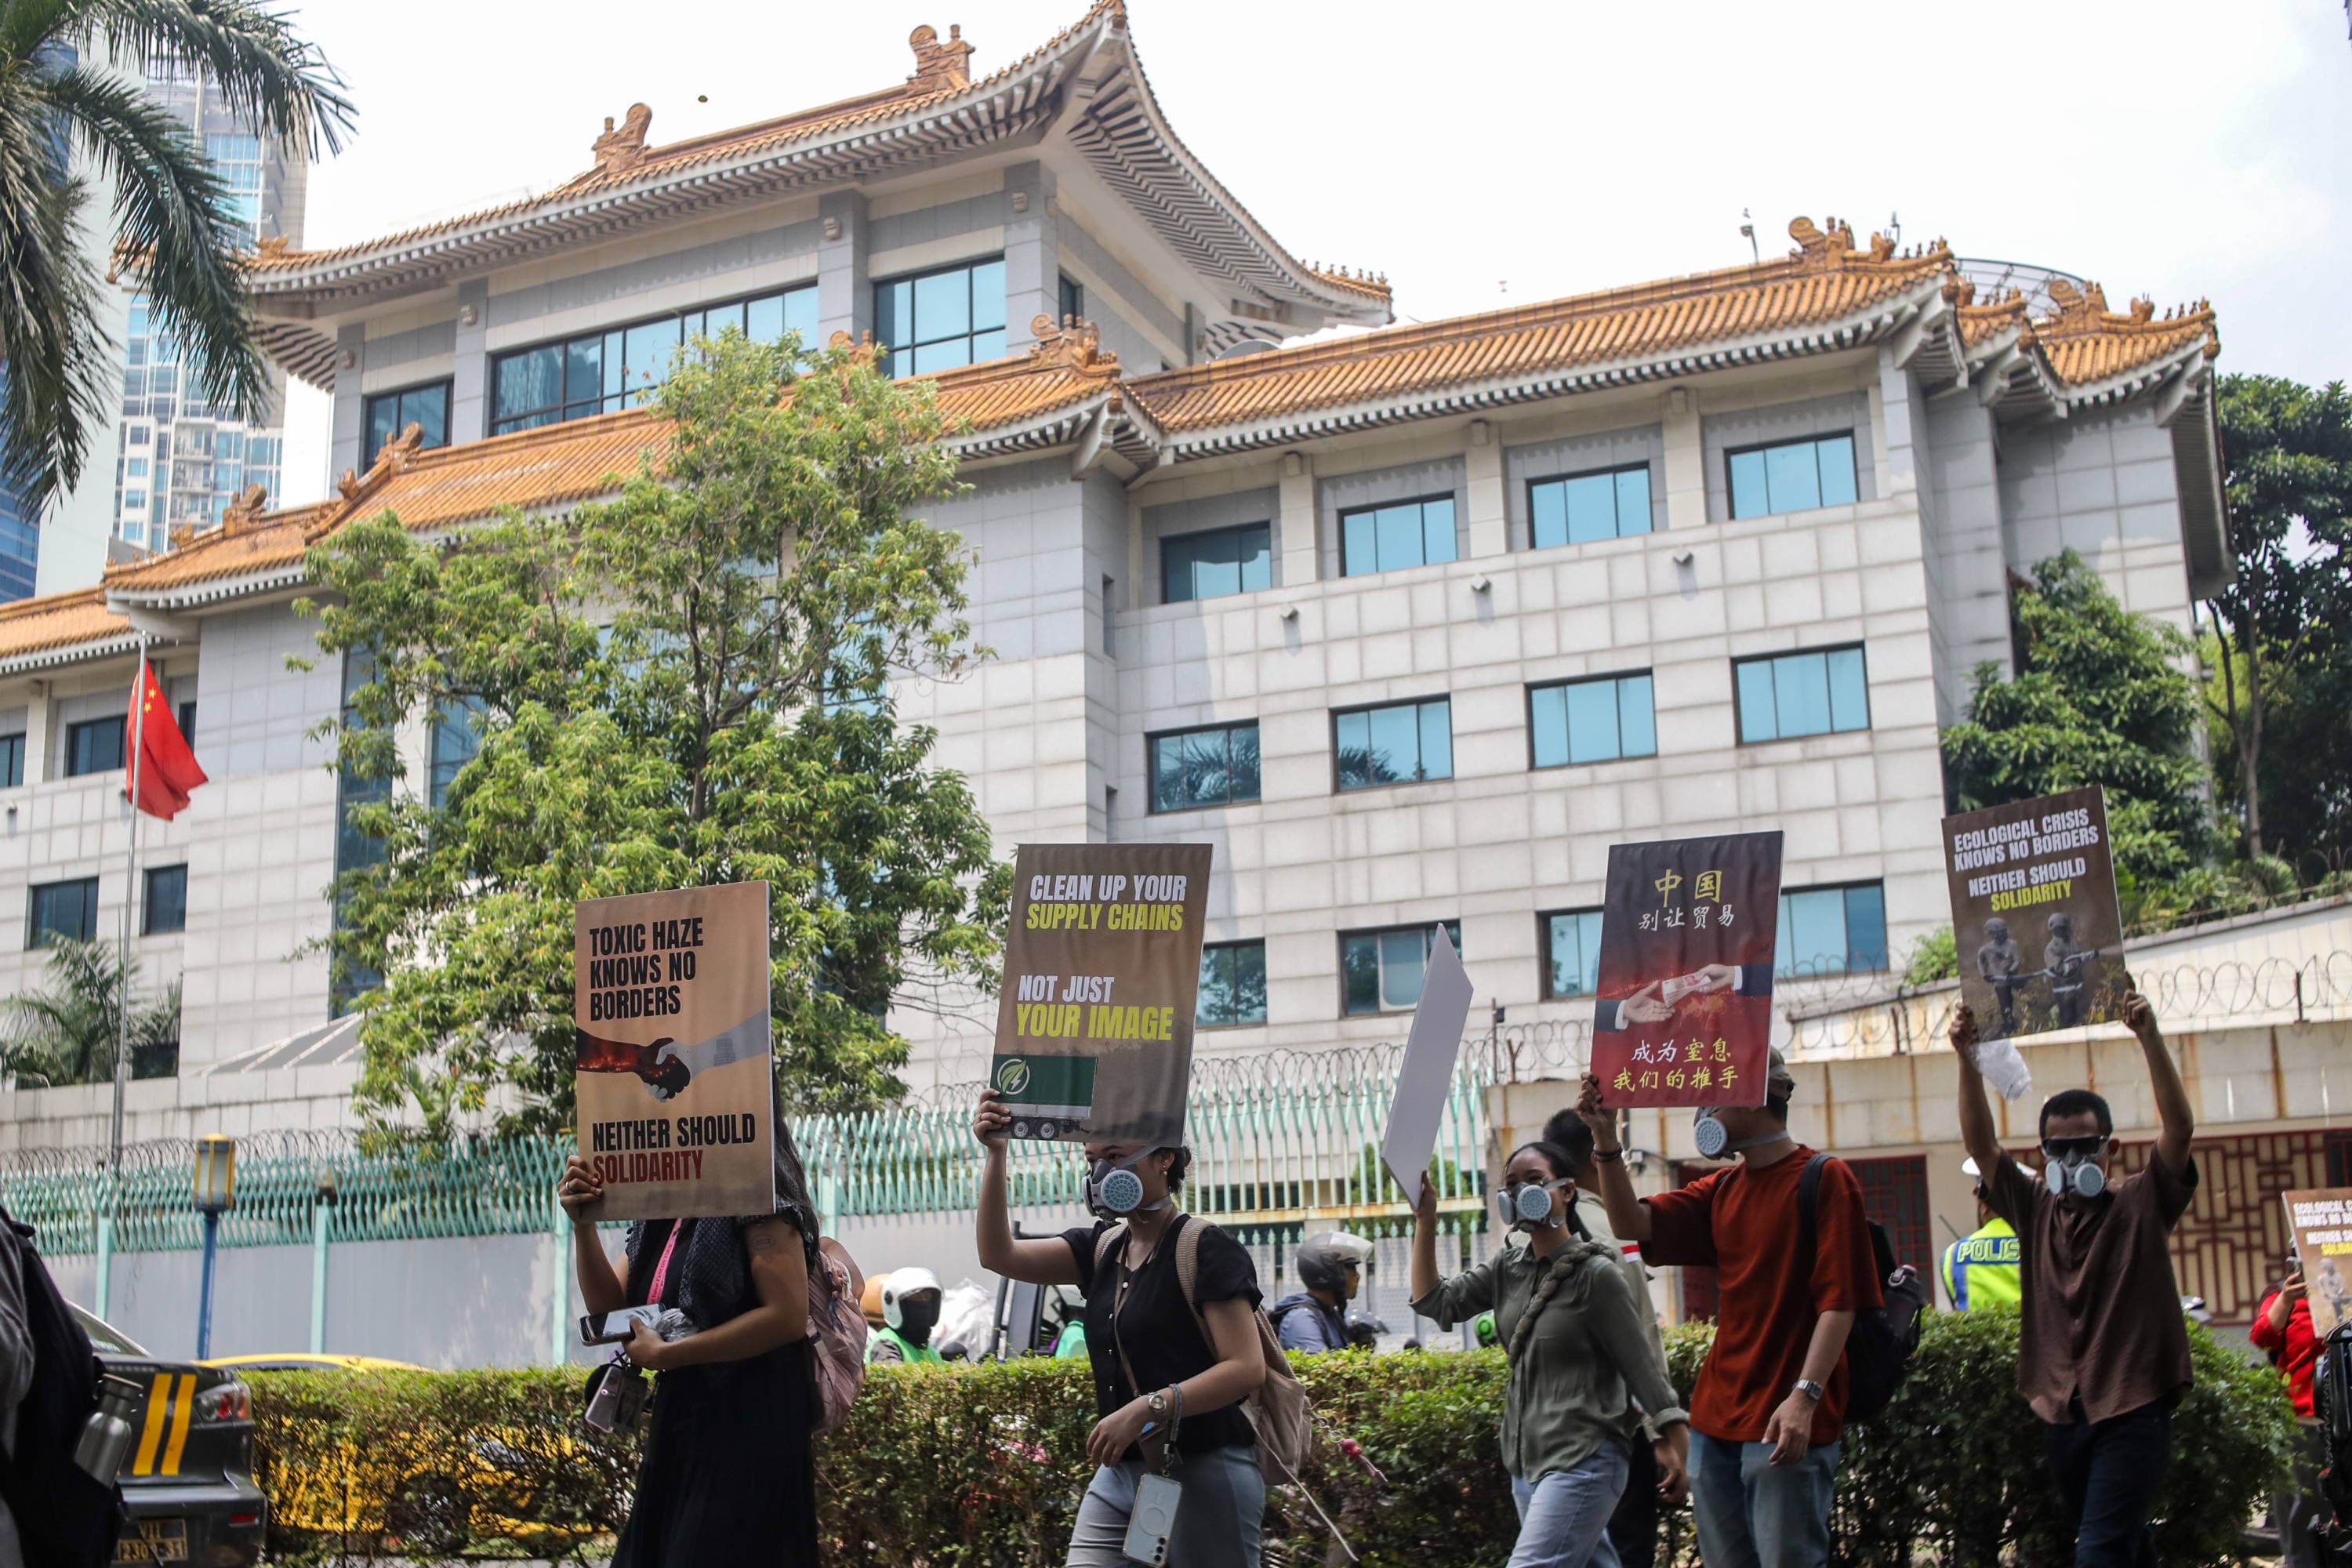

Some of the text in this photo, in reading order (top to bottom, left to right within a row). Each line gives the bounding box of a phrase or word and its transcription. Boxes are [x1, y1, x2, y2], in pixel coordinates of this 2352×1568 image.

[1954, 808, 2089, 853] ECOLOGICAL CRISIS
[1954, 826, 2099, 872] KNOWS NO BORDERS
[1029, 874, 1188, 902] CLEAN UP YOUR
[1654, 869, 1722, 908] 中国
[1968, 857, 2086, 898] NEITHER SHOULD
[1991, 879, 2072, 912] SOLIDARITY
[1026, 903, 1184, 931] SUPPLY CHAINS
[1638, 903, 1735, 931] 别让贸易
[590, 917, 703, 956] TOXIC HAZE
[590, 950, 696, 989] KNOWS NO
[590, 985, 681, 1021] BORDERS
[1018, 975, 1115, 1003] NOT JUST
[1016, 1004, 1174, 1040] YOUR IMAGE
[1631, 1036, 1731, 1064] 成为窒息
[1613, 1065, 1739, 1092] 我们的推手
[592, 1112, 756, 1152] NEITHER SHOULD
[593, 1149, 703, 1184] SOLIDARITY
